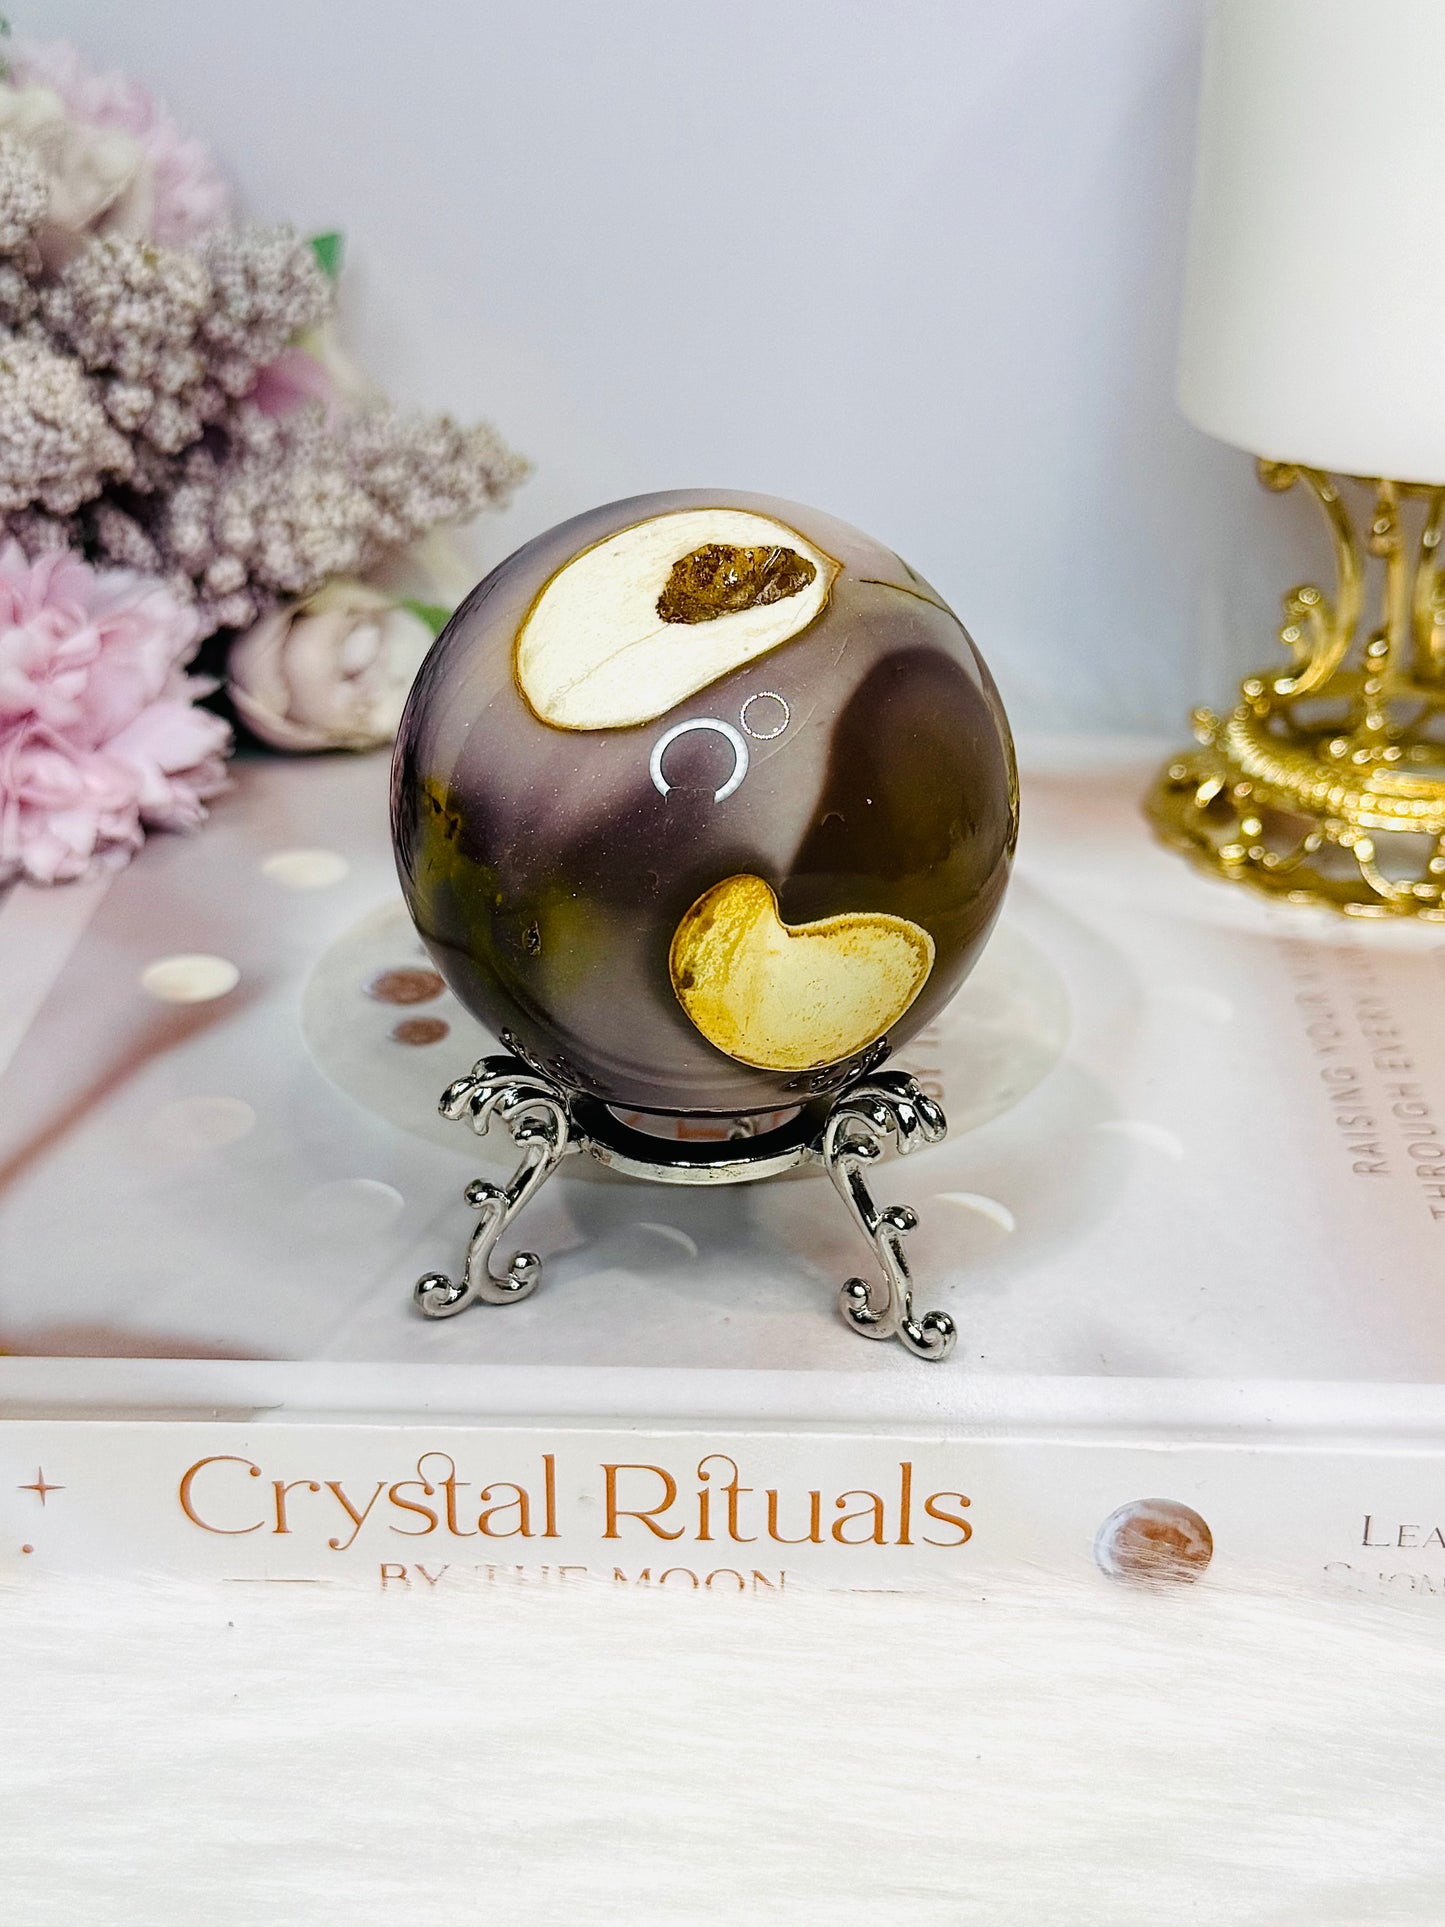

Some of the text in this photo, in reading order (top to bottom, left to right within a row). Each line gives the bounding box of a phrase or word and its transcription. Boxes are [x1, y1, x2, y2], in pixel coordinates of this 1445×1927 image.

[1319, 1065, 1392, 1177] RAISING
[179, 1452, 973, 1551] Crystal Rituals
